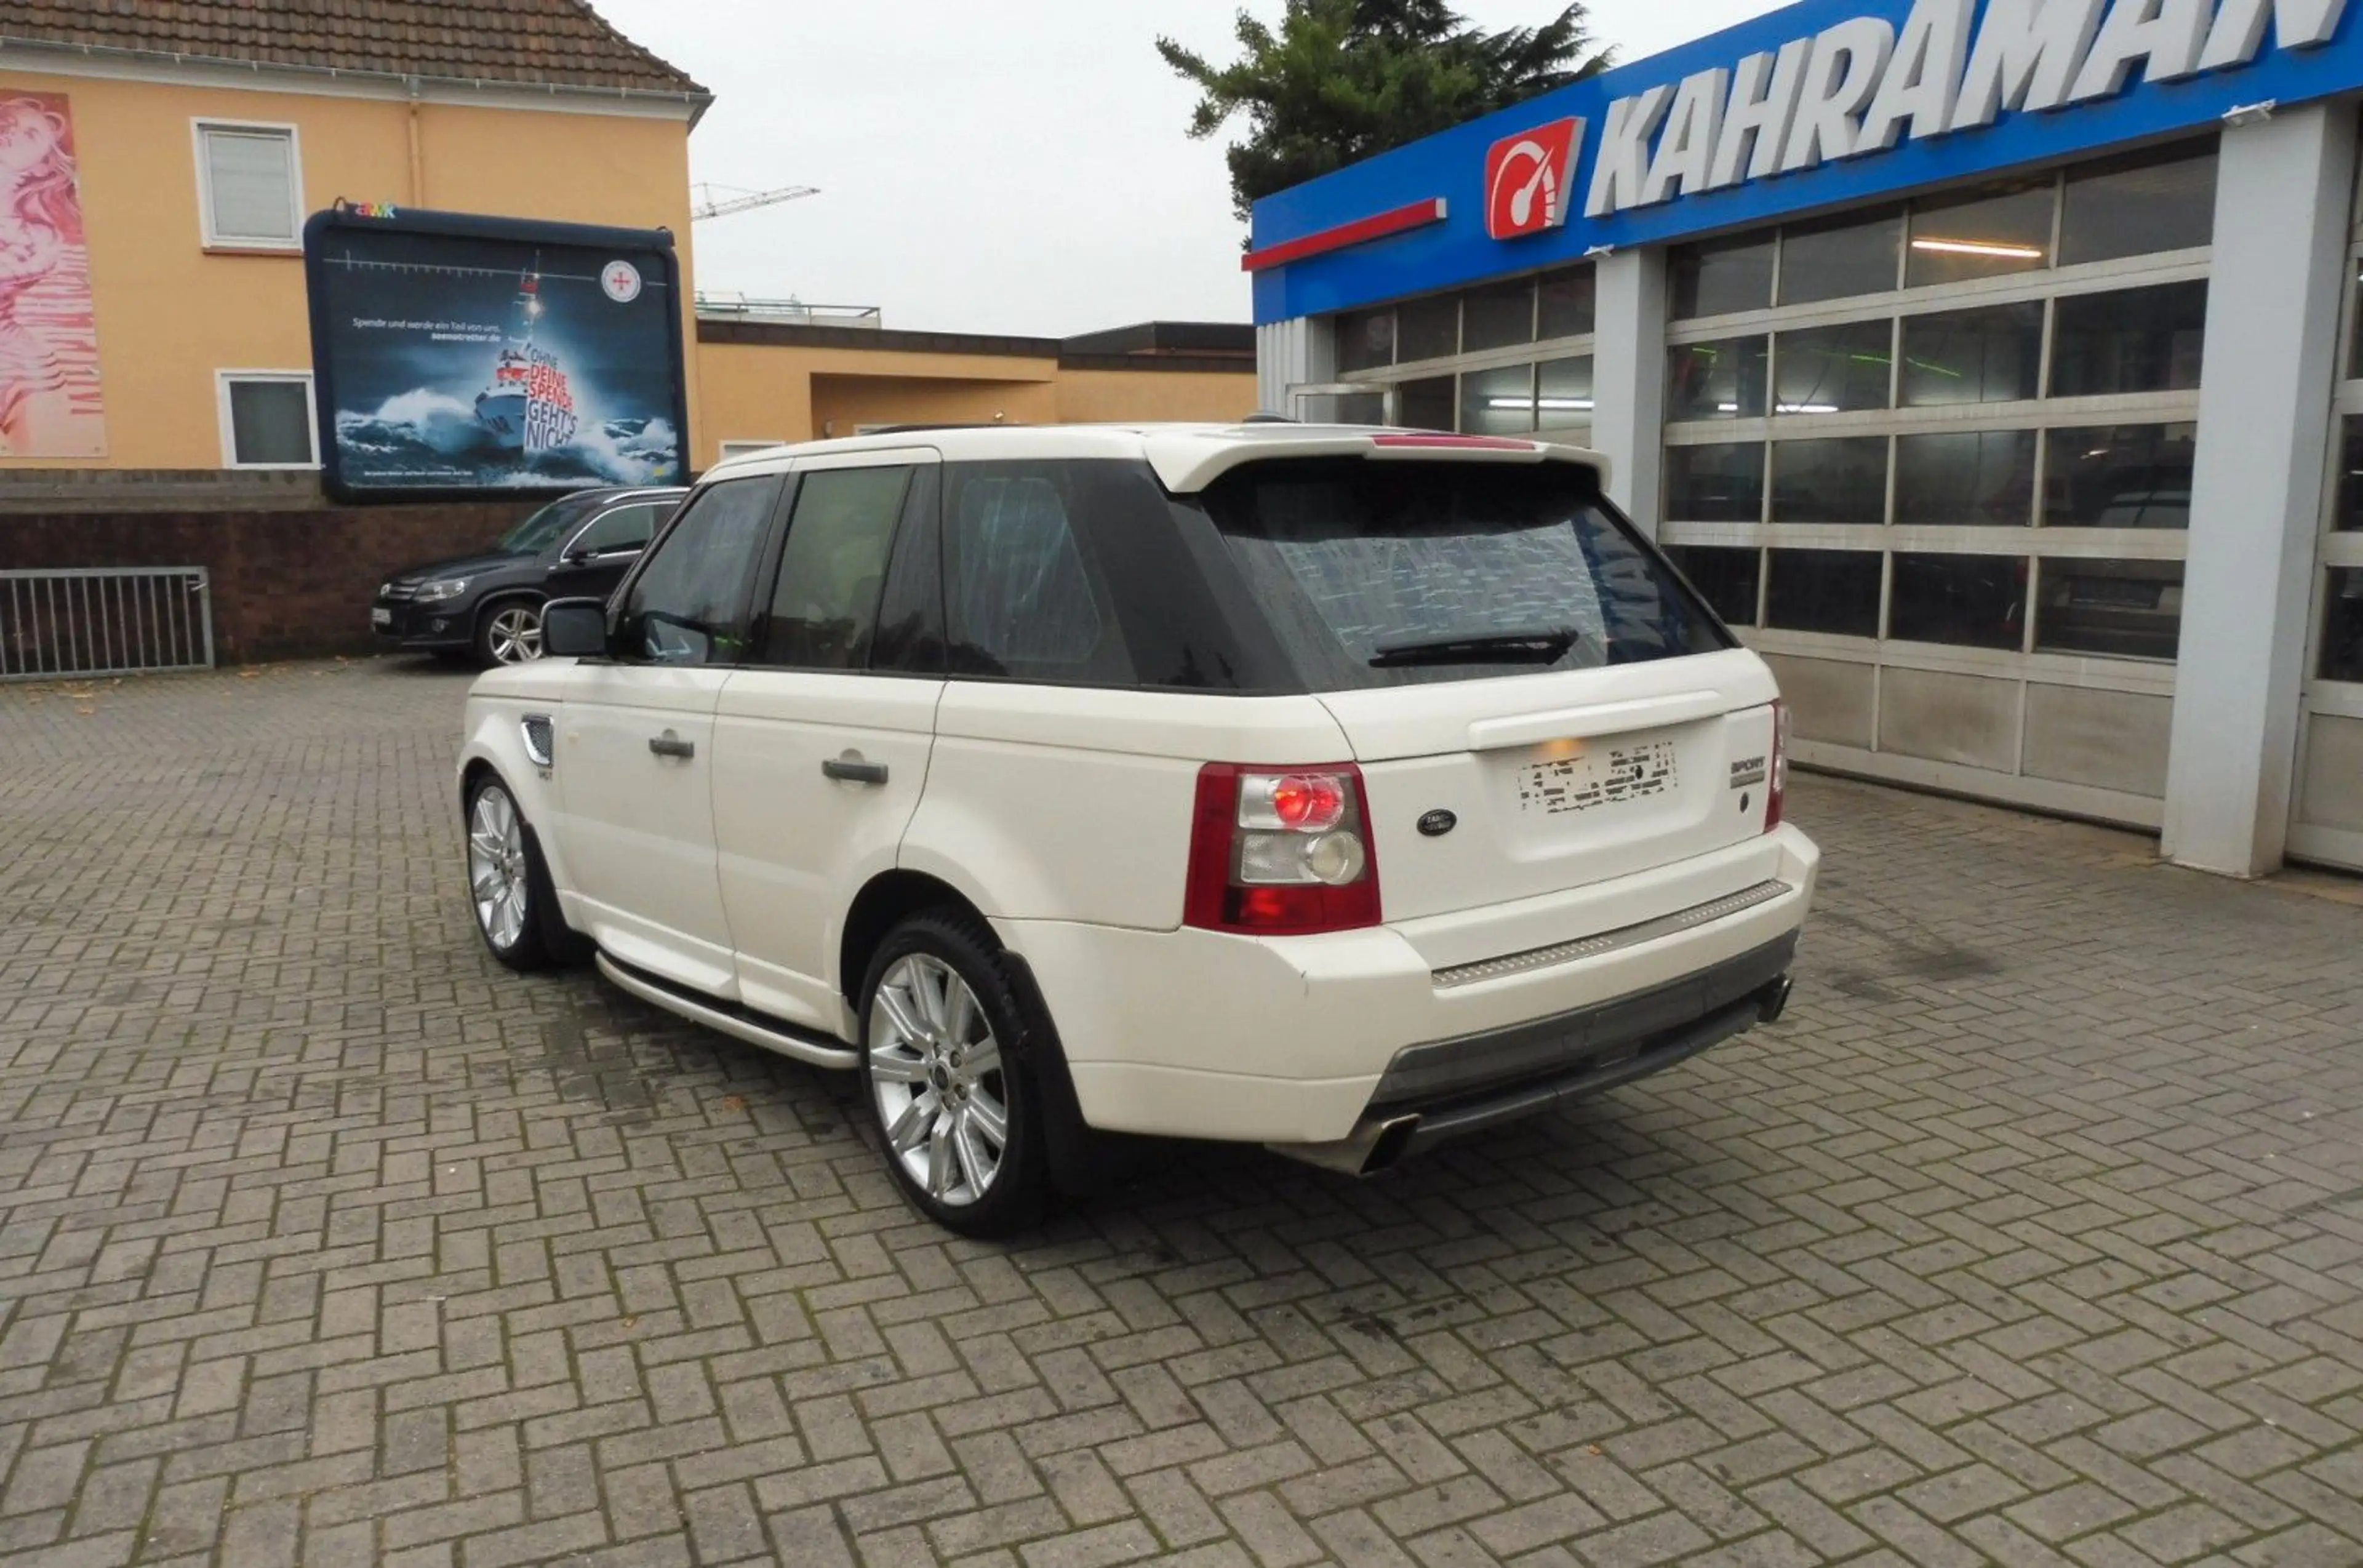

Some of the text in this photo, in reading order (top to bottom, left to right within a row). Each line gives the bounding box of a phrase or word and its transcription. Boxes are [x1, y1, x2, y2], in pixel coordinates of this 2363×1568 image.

[353, 317, 387, 329] Spende
[388, 319, 406, 329] und
[530, 348, 558, 369] OHNE
[530, 364, 567, 388] DEINE
[529, 381, 574, 412] SPENDE
[528, 399, 578, 434] GEHT'S
[526, 420, 572, 449] NICHT
[1730, 756, 1765, 775] SPORT
